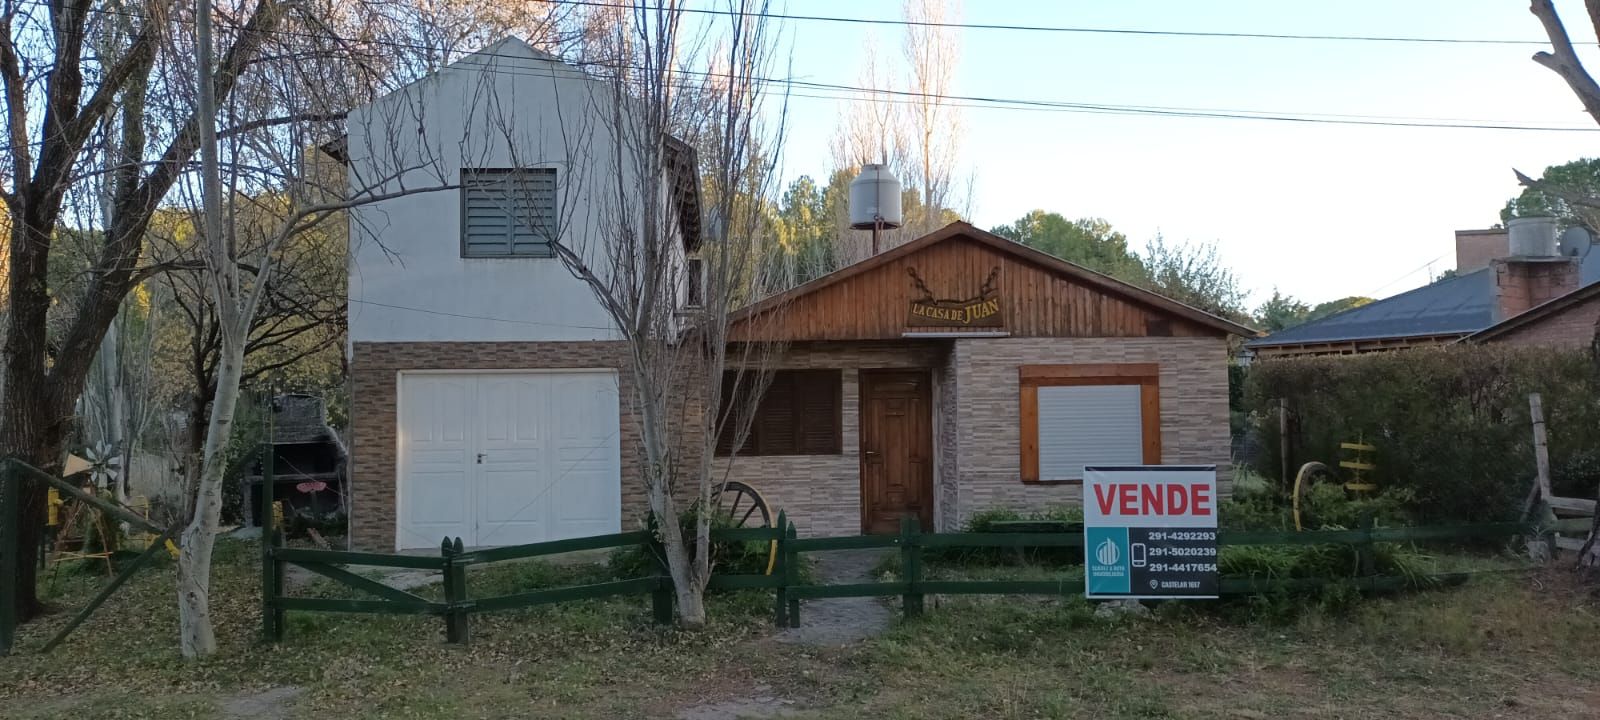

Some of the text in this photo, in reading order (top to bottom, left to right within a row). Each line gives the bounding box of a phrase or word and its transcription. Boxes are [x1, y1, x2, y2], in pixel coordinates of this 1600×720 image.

[912, 299, 999, 324] LA CASA DE JUAN
[1093, 483, 1211, 515] VENDE
[1148, 531, 1216, 541] 291-4292293
[1149, 547, 1217, 556] 291-5020239
[1149, 563, 1218, 572] 291-4417654
